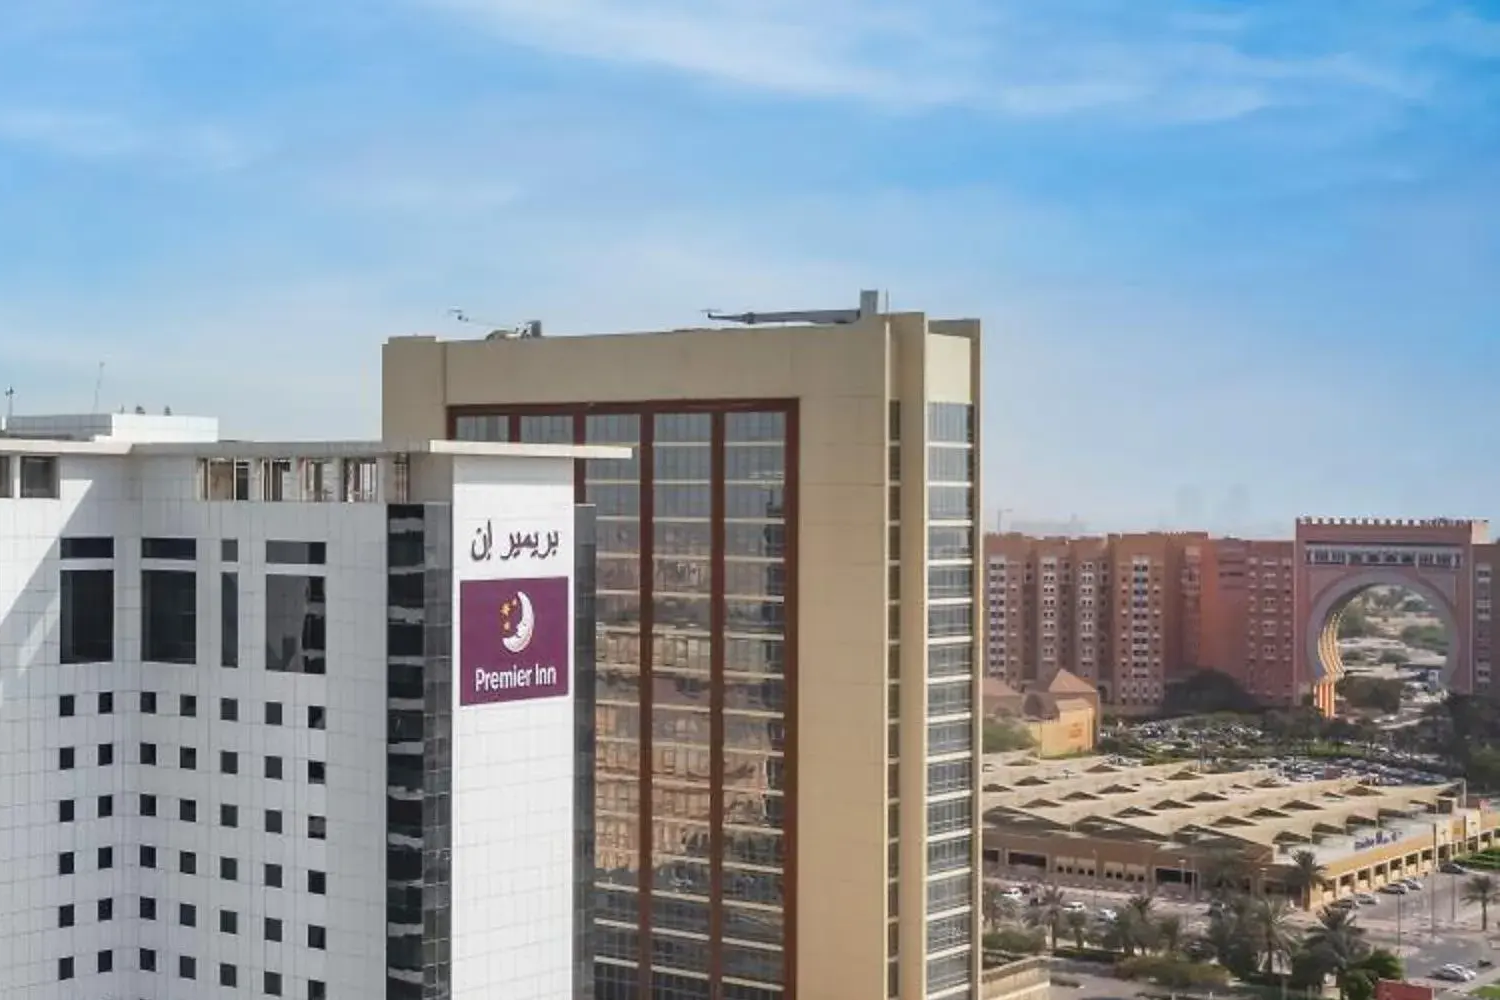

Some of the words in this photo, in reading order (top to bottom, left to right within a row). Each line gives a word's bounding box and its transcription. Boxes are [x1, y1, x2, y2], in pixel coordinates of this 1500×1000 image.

[471, 519, 492, 561] إن
[500, 527, 560, 560] بريمير
[474, 664, 533, 692] Premier
[535, 663, 557, 687] Inn
